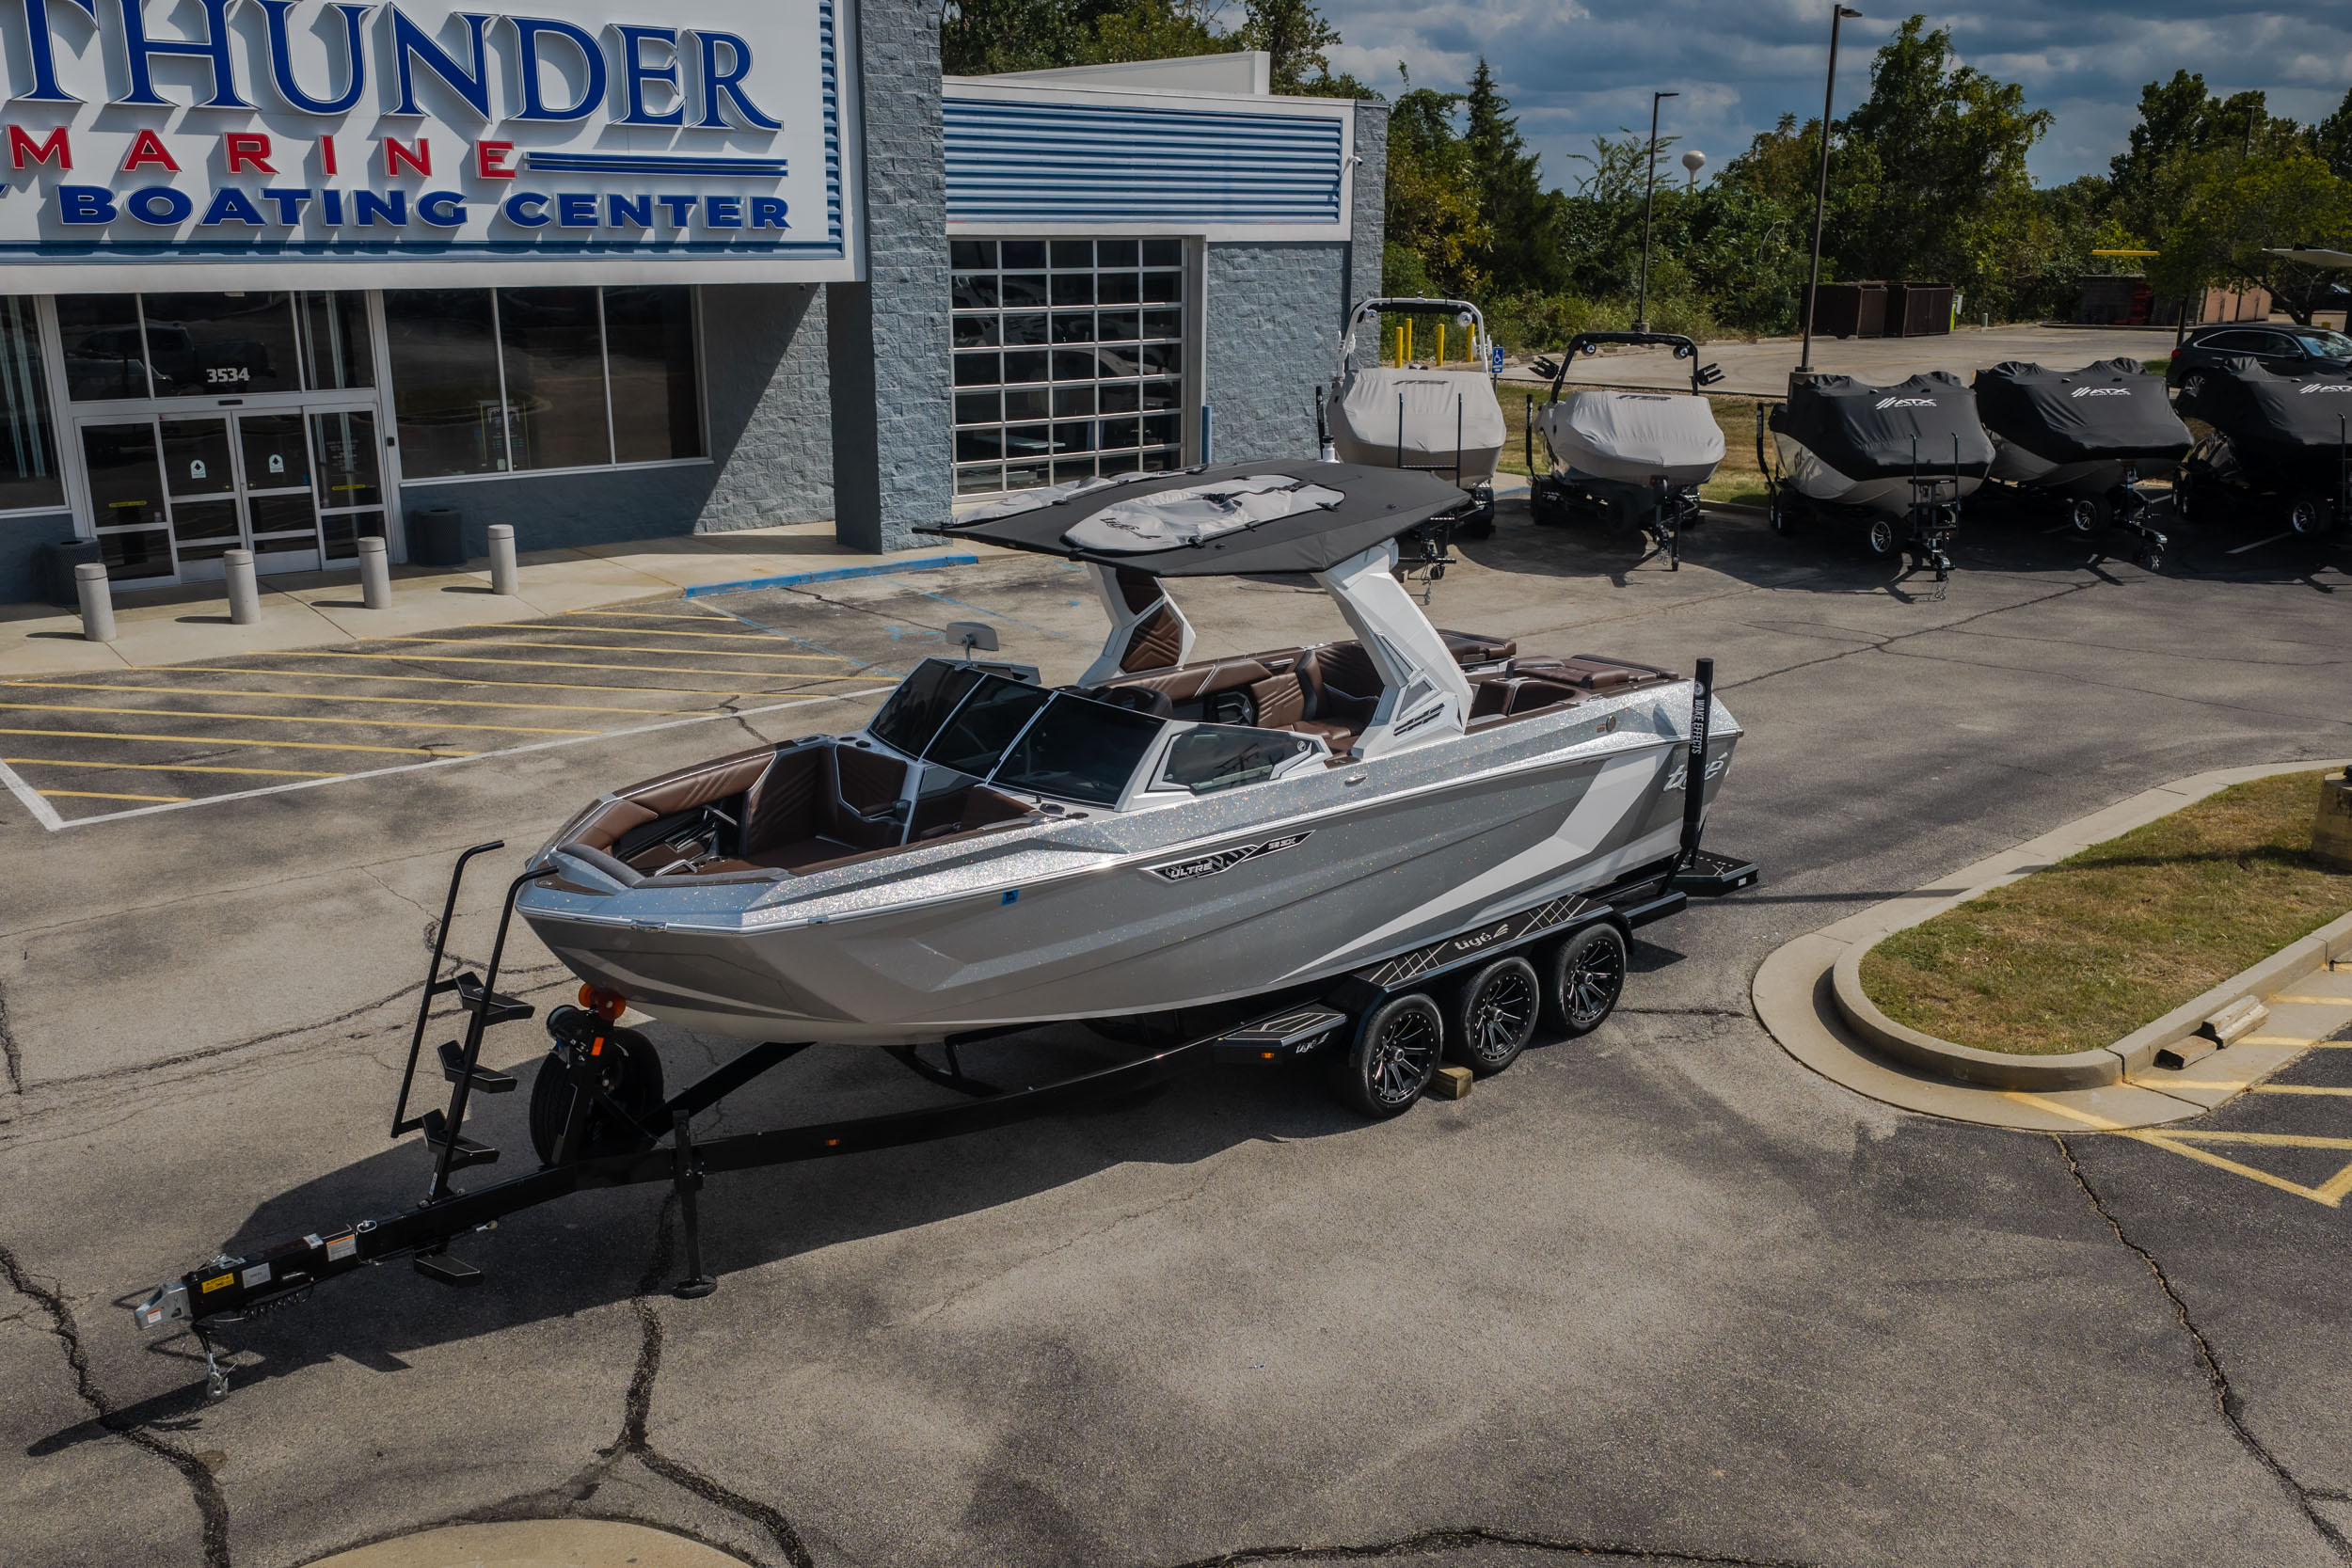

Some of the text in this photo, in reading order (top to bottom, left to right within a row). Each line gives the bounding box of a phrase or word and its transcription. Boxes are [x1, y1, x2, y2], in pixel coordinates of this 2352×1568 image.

[7, 124, 516, 180] MARINE
[56, 185, 791, 230] BOATING CENTER
[206, 367, 250, 383] 3534
[1692, 699, 1706, 754] WAKE EFFECTS
